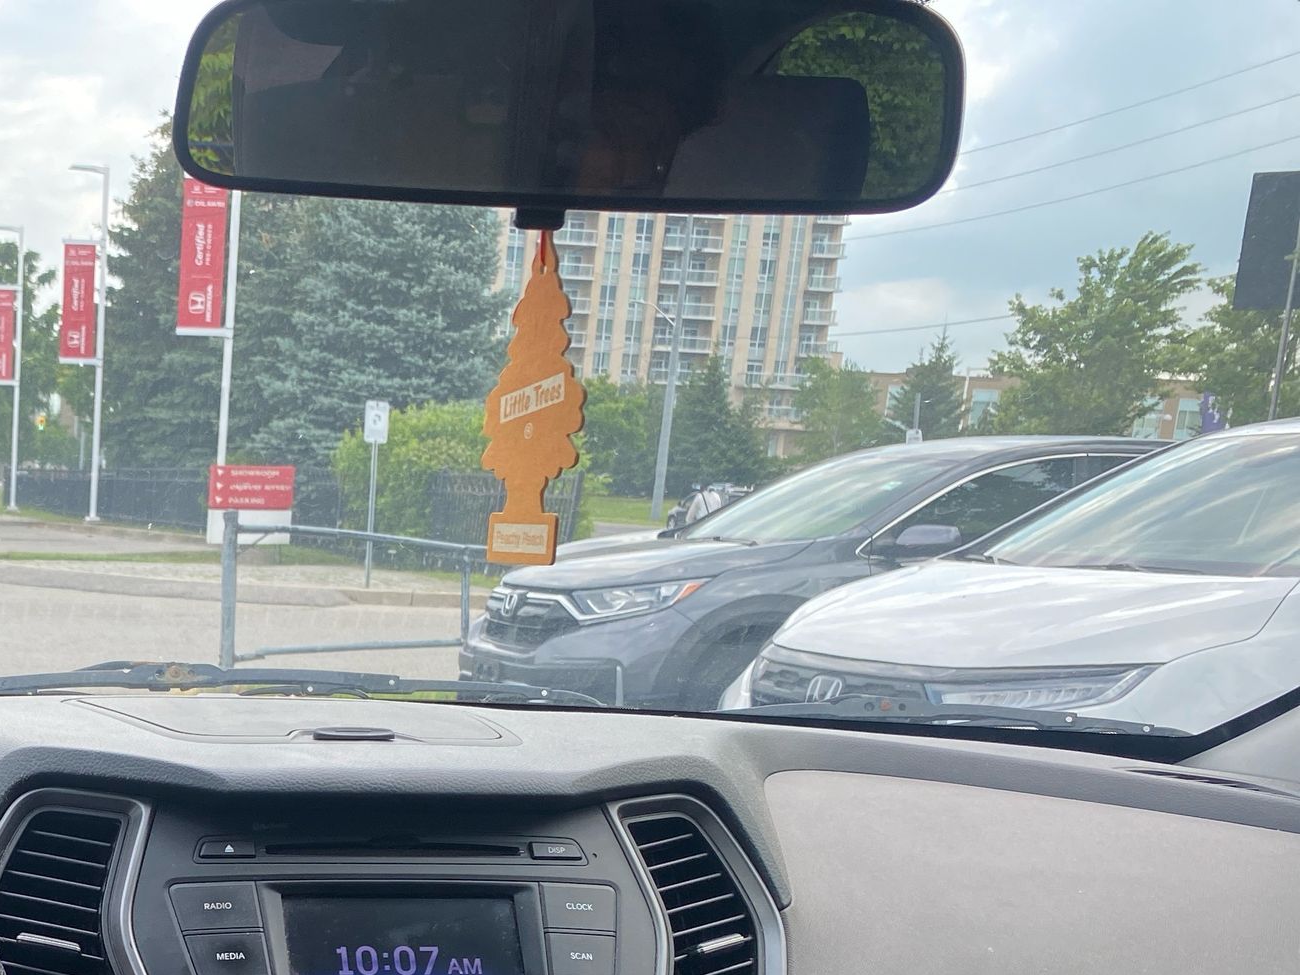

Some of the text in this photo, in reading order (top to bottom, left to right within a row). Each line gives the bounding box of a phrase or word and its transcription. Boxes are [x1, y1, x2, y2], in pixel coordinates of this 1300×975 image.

[504, 384, 561, 419] Little Trees
[204, 902, 232, 910] RADIO
[566, 902, 593, 911] CLOCK
[216, 952, 245, 961] MEDIA
[336, 945, 483, 975] 10:07 AM
[570, 952, 593, 961] SCAN
